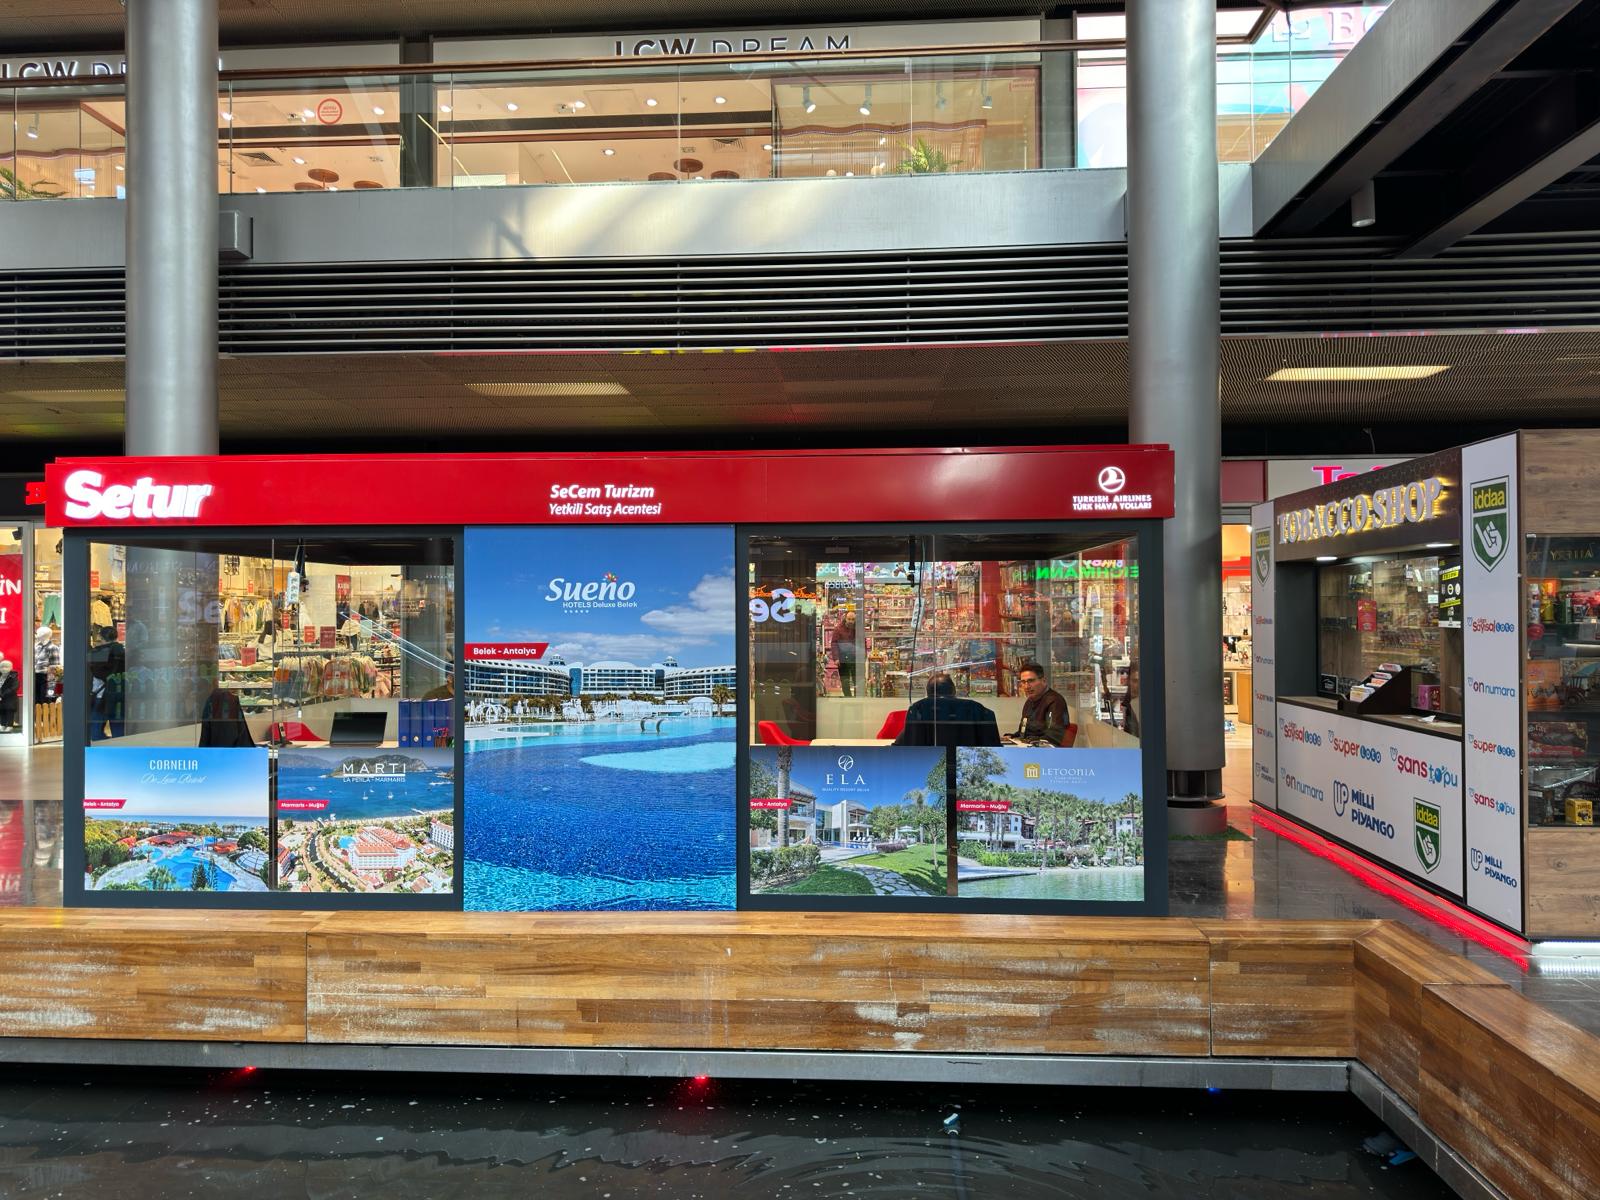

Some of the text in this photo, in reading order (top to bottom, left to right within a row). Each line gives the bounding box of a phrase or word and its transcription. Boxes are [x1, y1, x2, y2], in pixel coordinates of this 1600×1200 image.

[64, 470, 214, 520] Setur
[550, 484, 655, 498] SeCem Turizm
[1072, 494, 1152, 503] TURKISH AIRLINES
[1072, 501, 1152, 511] TÜRK HAVA YOLLARI
[1474, 488, 1505, 510] iddaa
[549, 503, 662, 517] Yetkili Satış Acentesi
[1277, 477, 1444, 545] TOBACCO SHOP
[473, 647, 497, 655] Belek
[503, 647, 537, 656] Antalya
[1473, 681, 1516, 697] on numara
[149, 759, 199, 771] CORNELIA
[826, 773, 867, 785] ELA
[1285, 774, 1296, 790] on
[1296, 780, 1324, 802] numara
[1351, 808, 1395, 839] PİYANGO
[1415, 805, 1439, 827] iddaa
